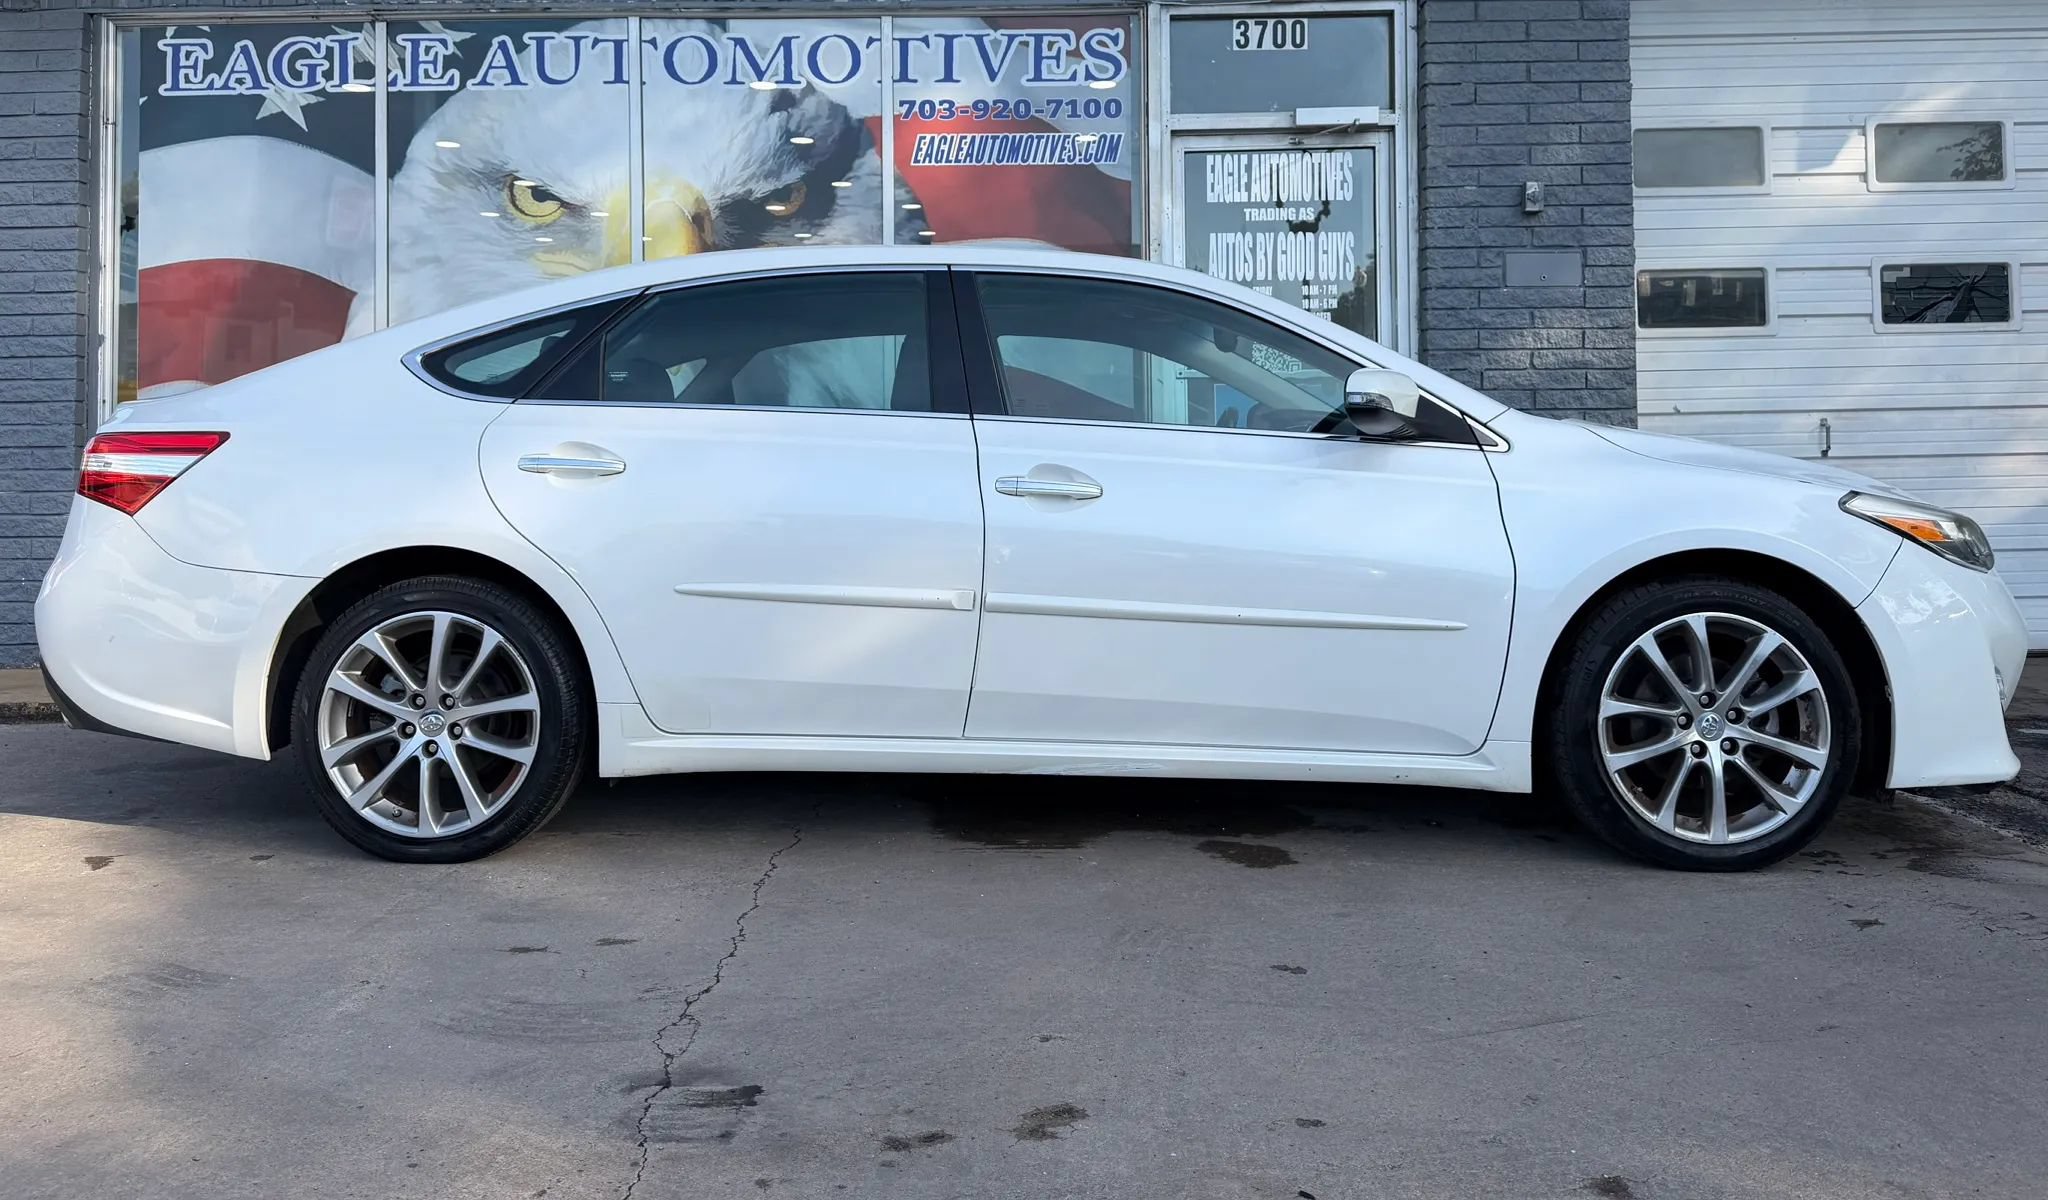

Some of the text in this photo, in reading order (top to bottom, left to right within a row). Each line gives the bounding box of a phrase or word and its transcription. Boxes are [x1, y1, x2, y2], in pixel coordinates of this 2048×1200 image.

[1235, 19, 1306, 49] 3700
[160, 32, 1125, 93] EAGLE AUTOMOTIVES
[899, 98, 1123, 120] 703-920-7100
[912, 133, 1123, 165] EAGLEAUTOMOTIVES.COM
[1206, 152, 1353, 203] EAGLE AUTOMOTIVES
[1244, 207, 1315, 221] TRADING AS
[1208, 231, 1355, 282] AUTOS BY GOOD GUYS
[1301, 285, 1309, 296] 10
[1309, 285, 1319, 295] AM
